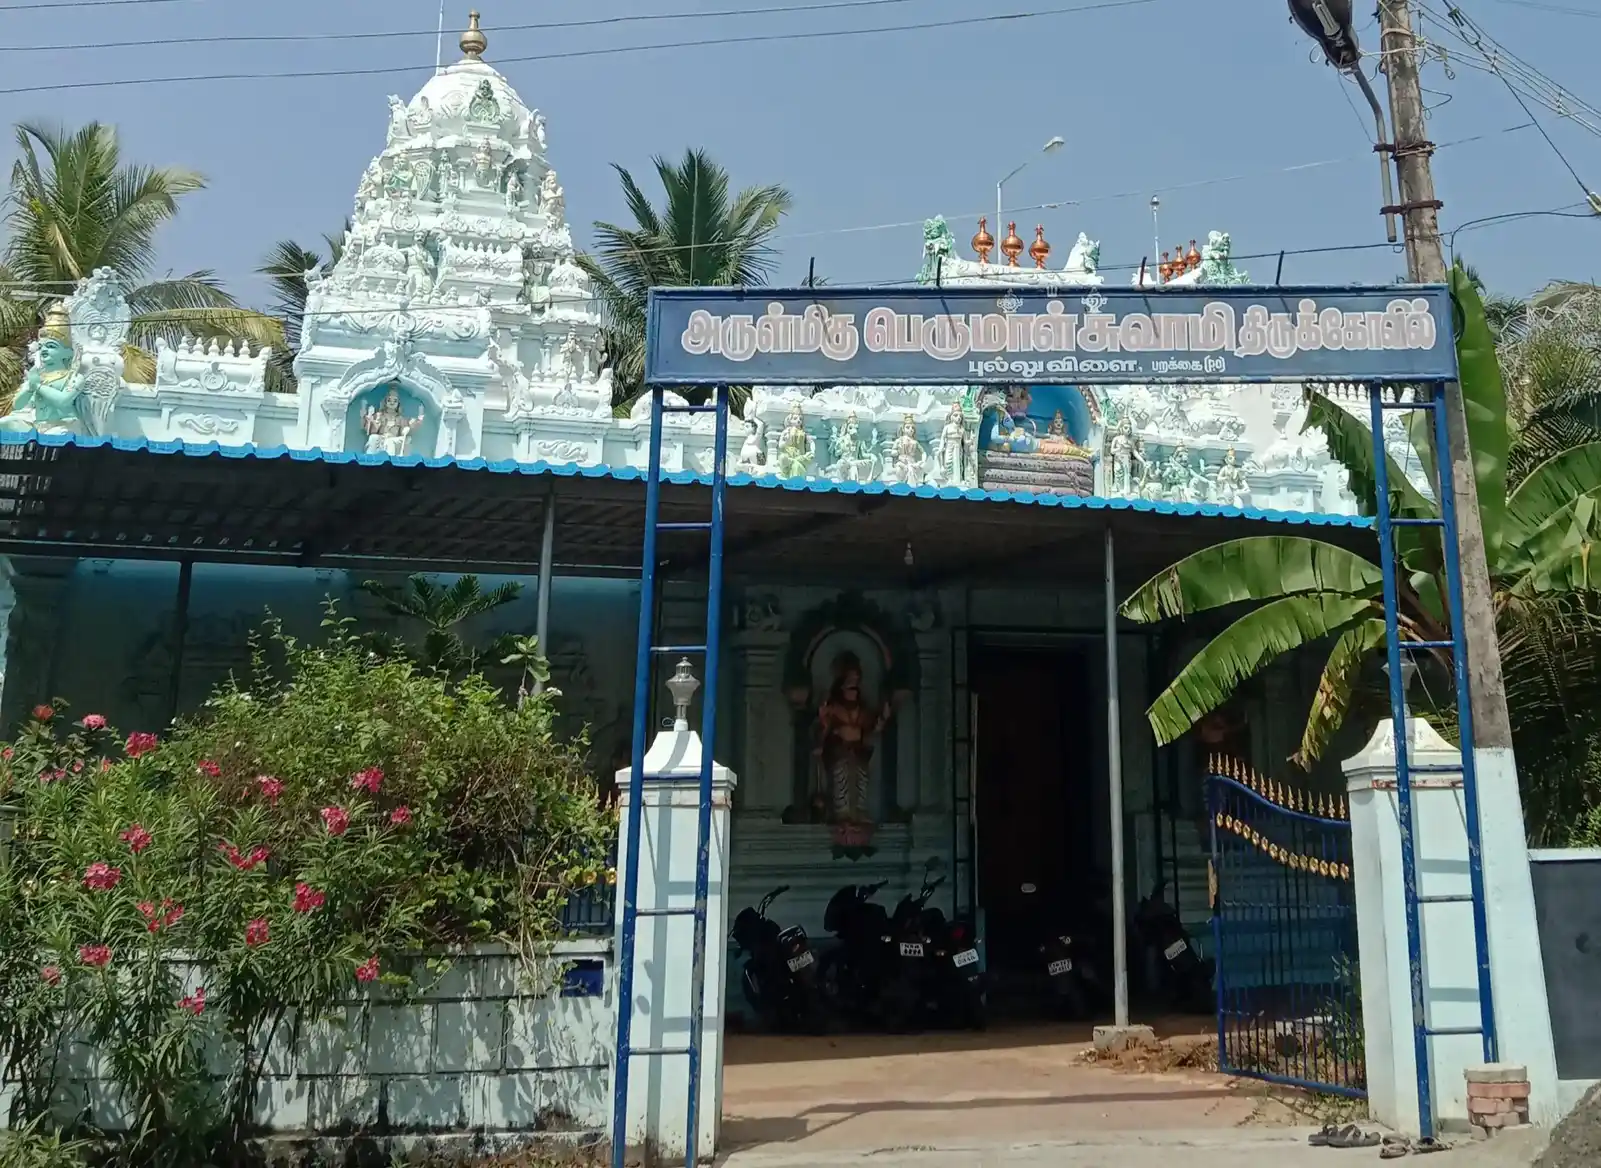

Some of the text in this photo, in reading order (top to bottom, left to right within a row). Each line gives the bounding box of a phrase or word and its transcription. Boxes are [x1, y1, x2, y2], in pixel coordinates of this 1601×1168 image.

[681, 298, 1437, 362] அருள்மிகு பெருமாள் சுவாமி திருக்கோவில்
